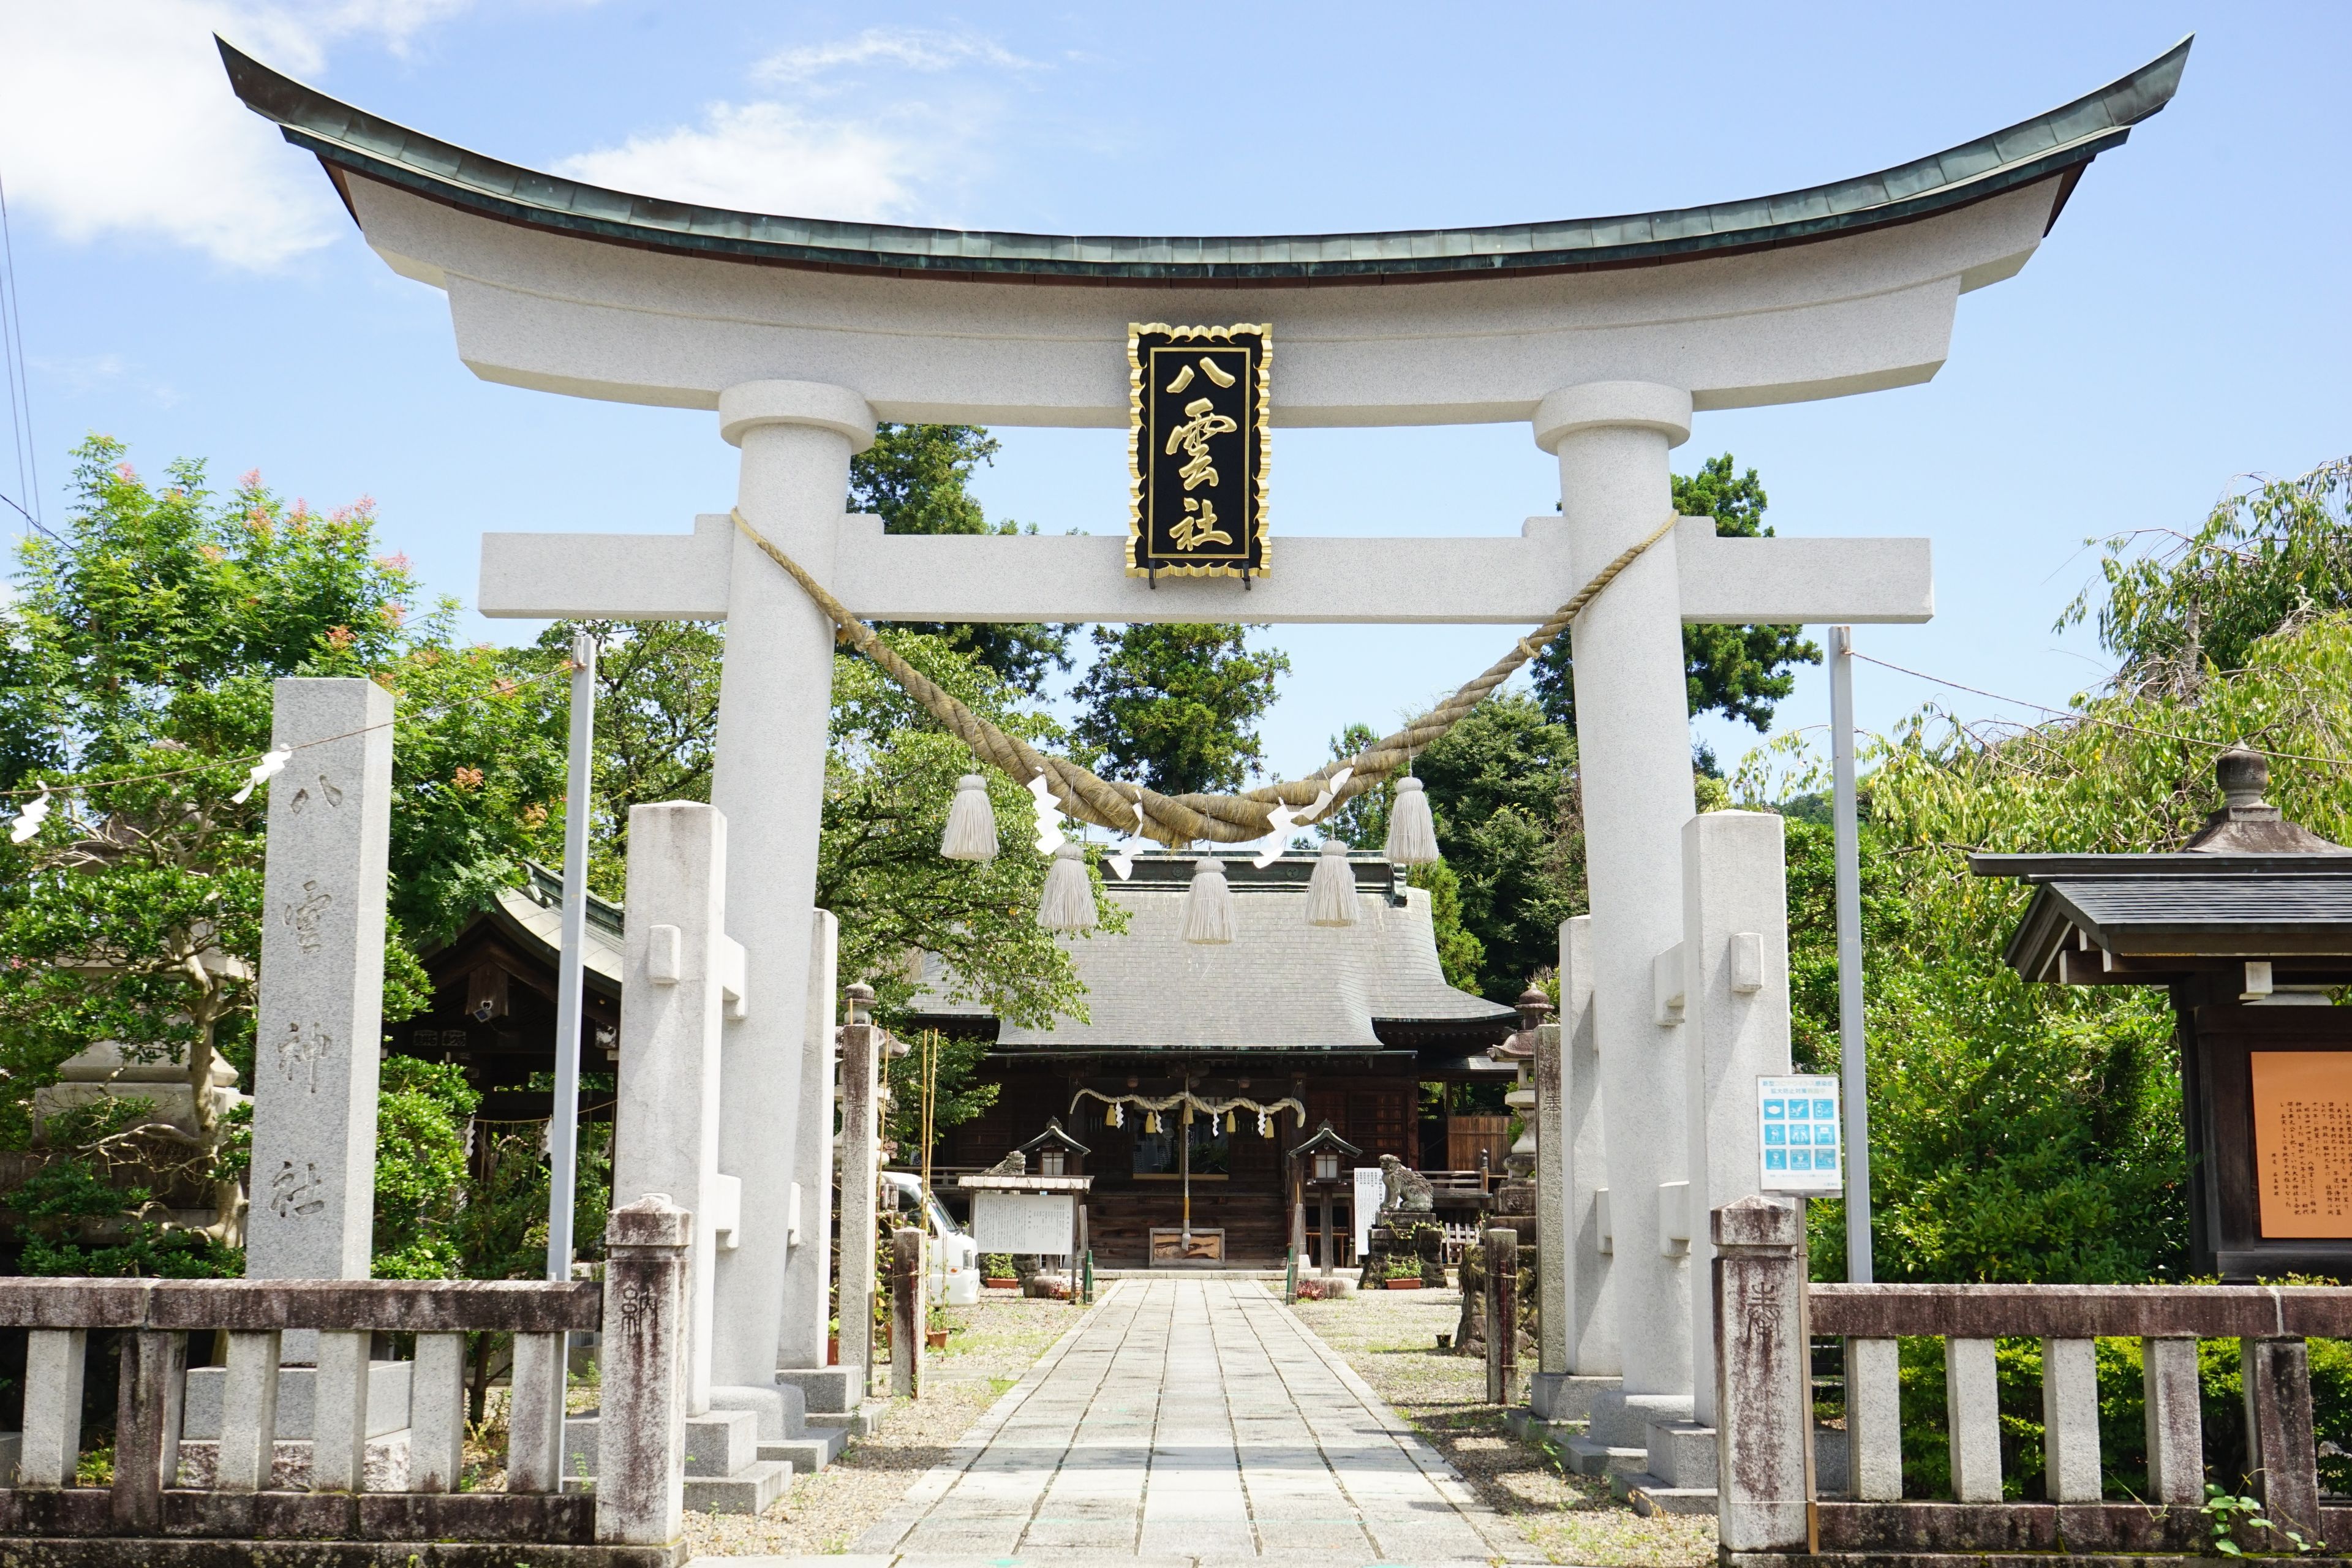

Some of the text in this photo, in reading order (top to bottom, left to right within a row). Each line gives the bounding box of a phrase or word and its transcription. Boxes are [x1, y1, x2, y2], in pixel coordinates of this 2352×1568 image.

[1166, 356, 1237, 551] 八雲社
[270, 774, 343, 1218] 八雲神社
